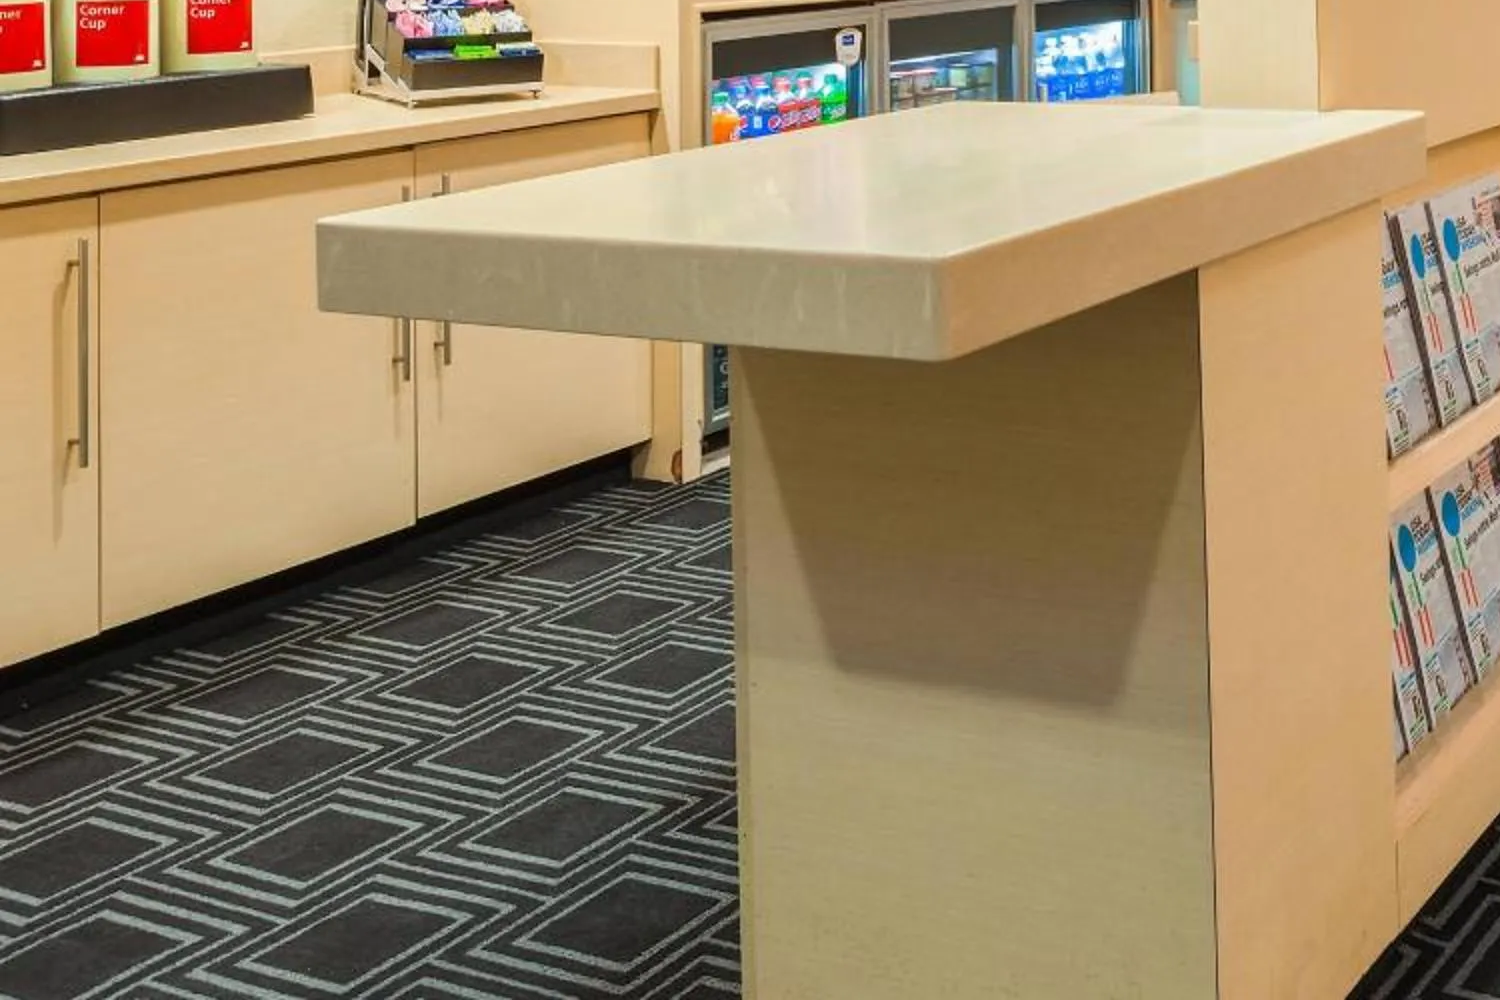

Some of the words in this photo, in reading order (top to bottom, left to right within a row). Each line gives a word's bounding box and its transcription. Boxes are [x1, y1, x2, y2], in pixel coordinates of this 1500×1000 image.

[79, 4, 125, 18] Corner
[189, 6, 216, 20] Cup
[79, 17, 107, 31] Cup
